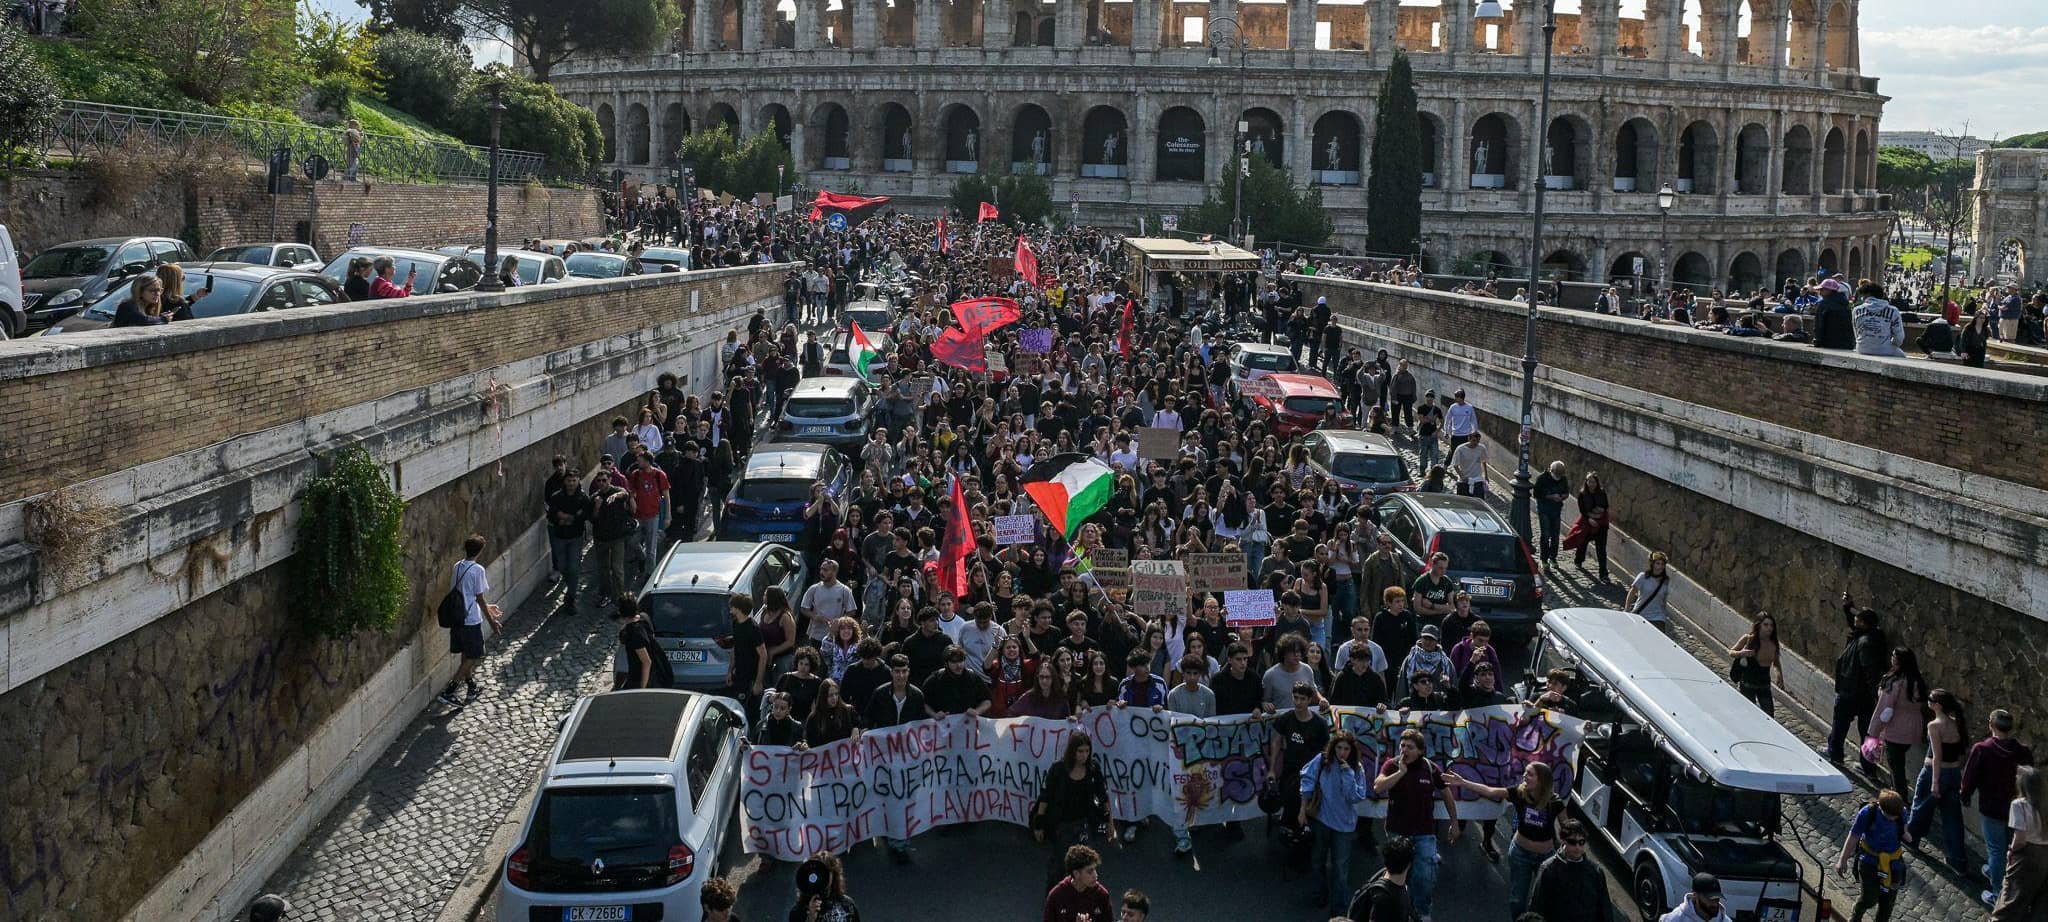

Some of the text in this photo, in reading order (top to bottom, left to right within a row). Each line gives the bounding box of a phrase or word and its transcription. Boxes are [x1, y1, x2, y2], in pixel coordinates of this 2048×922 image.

[1009, 712, 1117, 760] FUTO
[1130, 715, 1169, 742] OS
[744, 781, 866, 822] CONTRO
[980, 755, 1048, 798] RiARM
[905, 801, 921, 839] E
[589, 906, 624, 920] 726BC
